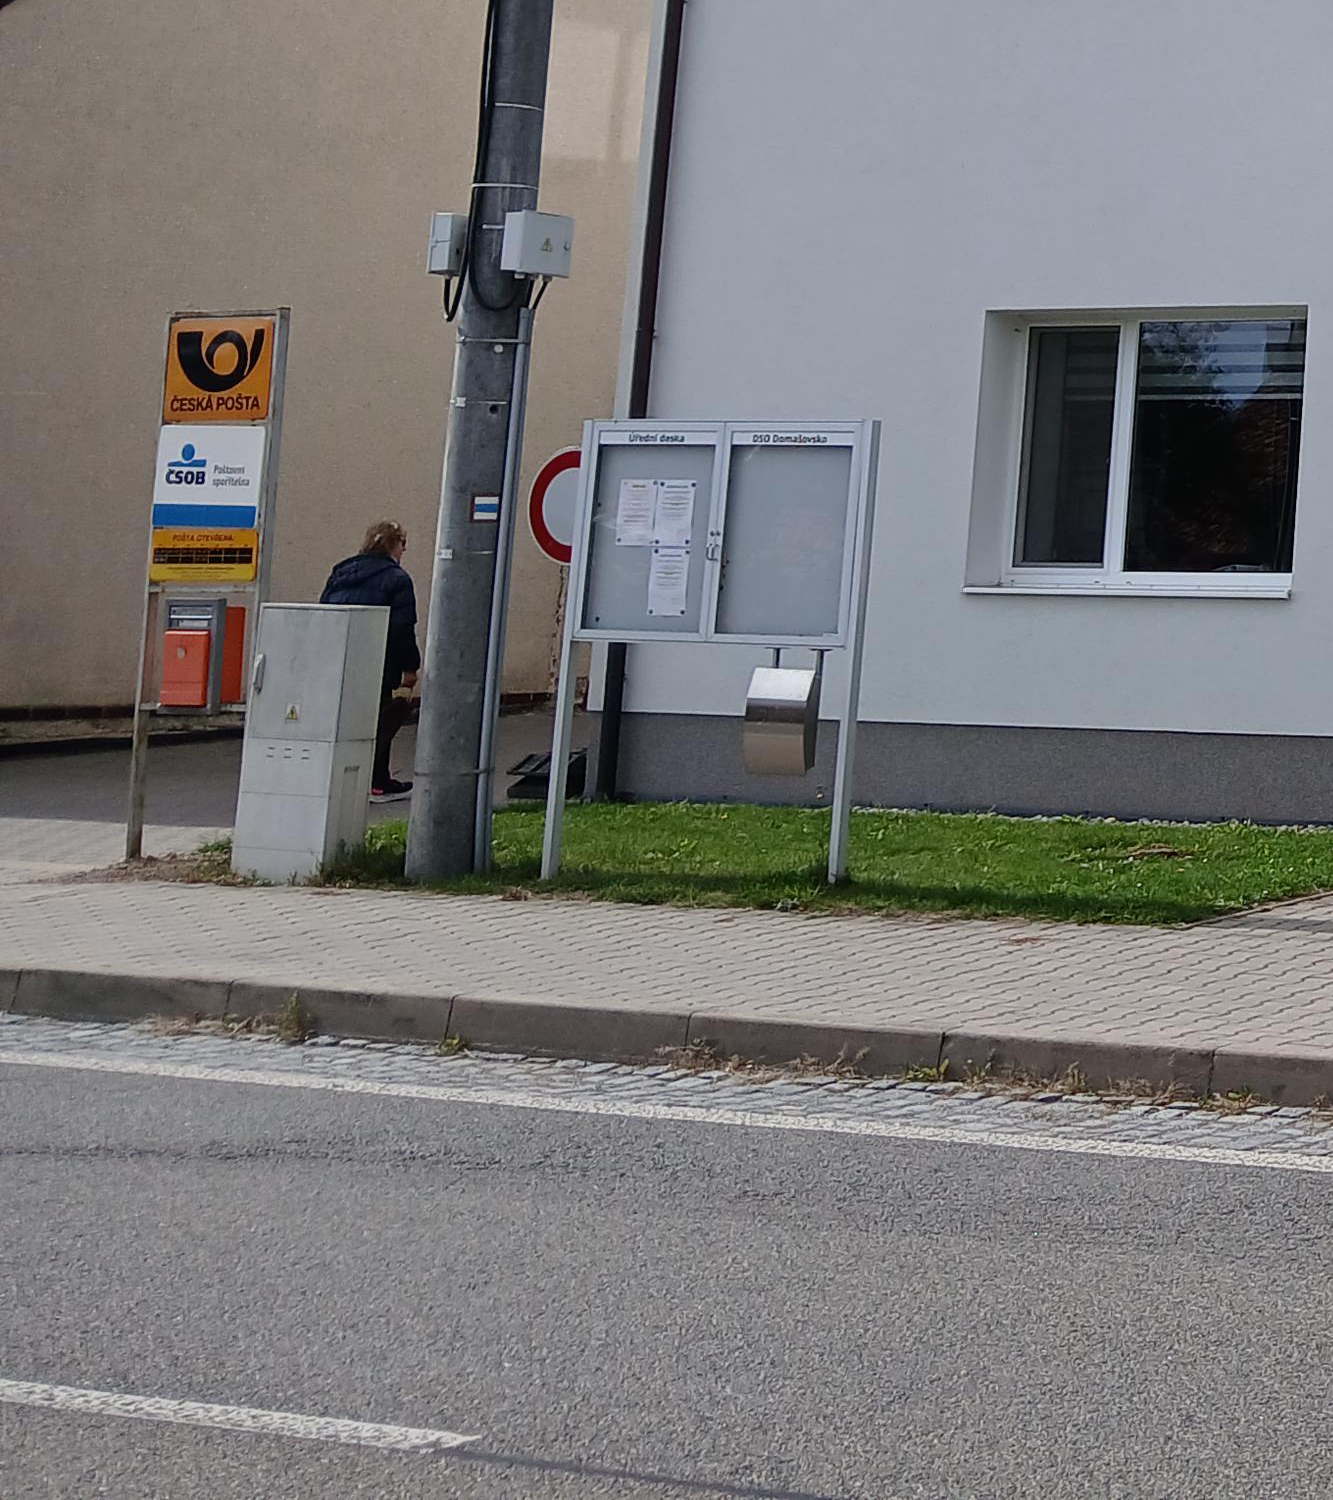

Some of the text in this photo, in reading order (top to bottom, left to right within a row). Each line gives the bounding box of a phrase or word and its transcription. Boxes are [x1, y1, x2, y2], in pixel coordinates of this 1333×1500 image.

[170, 393, 260, 412] ČESKÁ POŠTA
[628, 432, 685, 443] Úřední deska
[772, 433, 828, 444] Domašovsko
[165, 468, 206, 485] ČSOB
